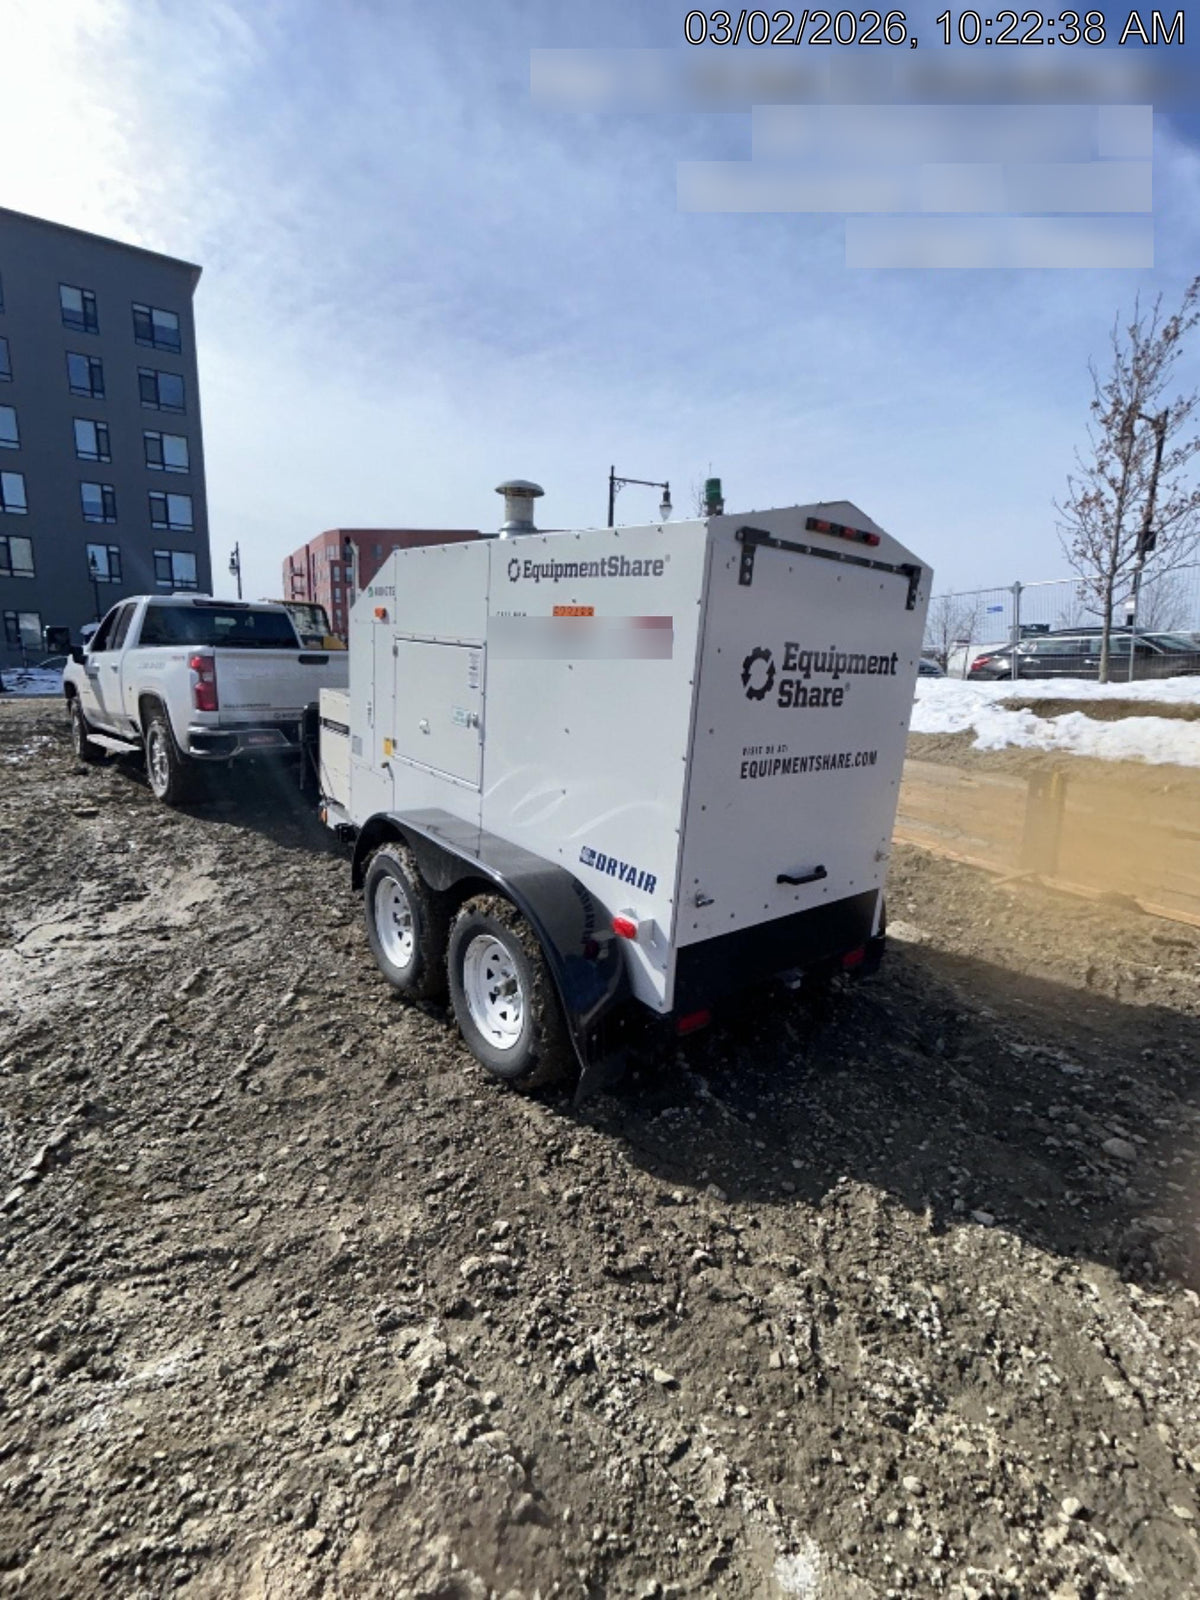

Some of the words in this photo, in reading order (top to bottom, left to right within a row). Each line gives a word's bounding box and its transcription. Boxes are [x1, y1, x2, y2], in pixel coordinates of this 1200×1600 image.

[523, 554, 664, 583] EquipmentShare
[782, 641, 898, 680] Equipment
[777, 679, 844, 708] Share
[740, 750, 878, 779] EQUIPMENTSHARE.COM
[595, 852, 657, 895] DRYAIR
